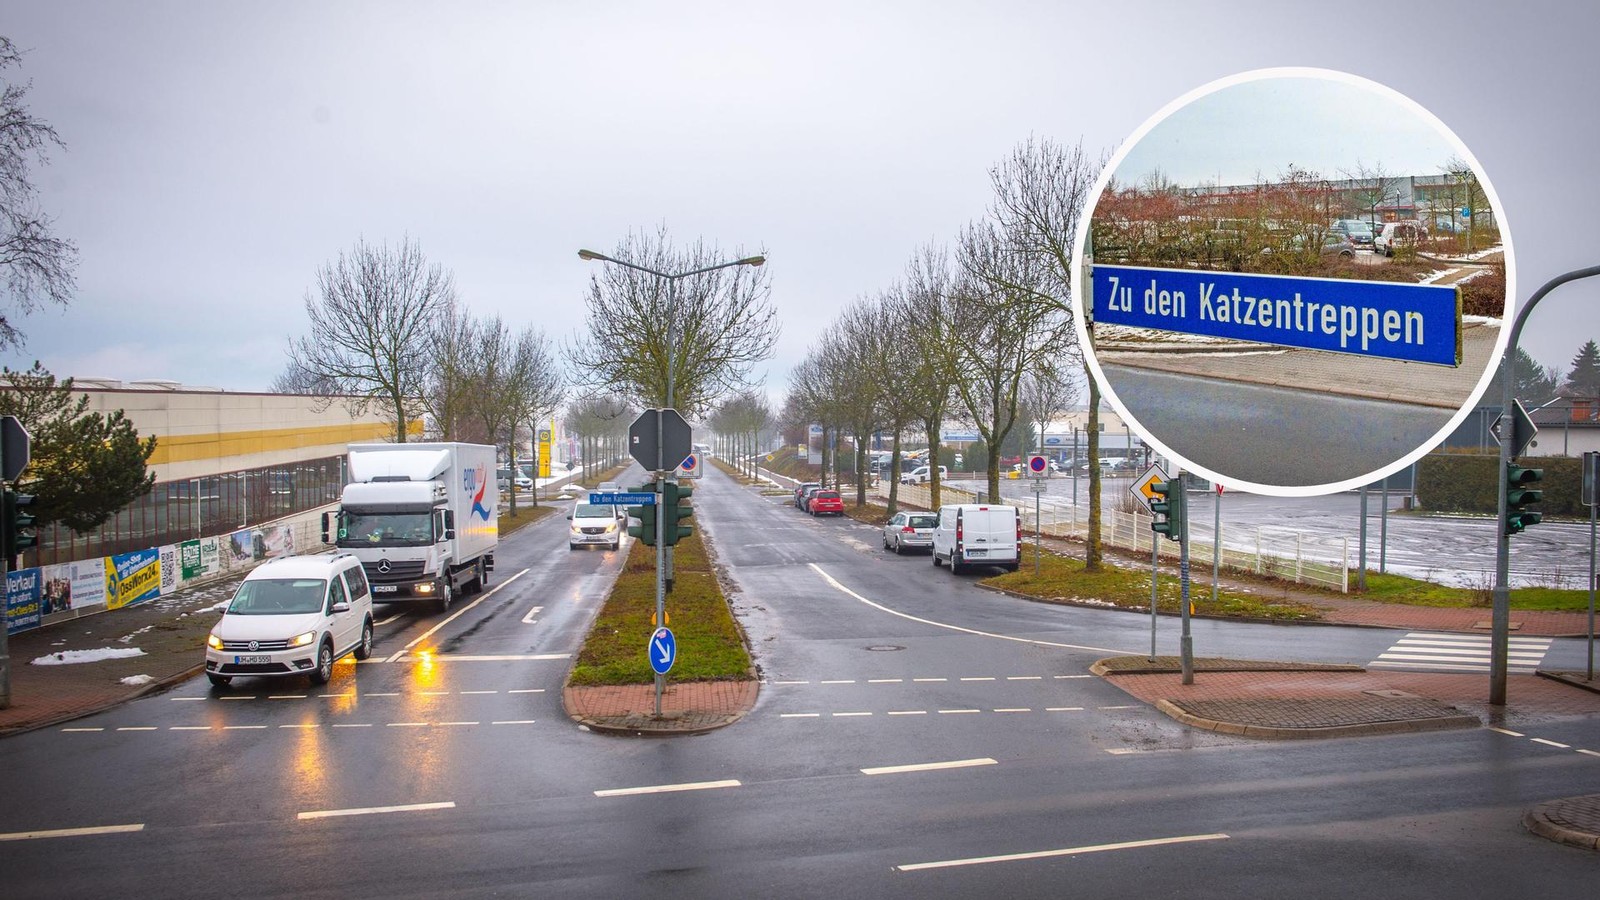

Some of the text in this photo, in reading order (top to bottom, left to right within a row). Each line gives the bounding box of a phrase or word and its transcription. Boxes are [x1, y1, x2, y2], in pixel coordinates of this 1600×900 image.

[1108, 276, 1424, 351] Zu den Katzentreppen
[593, 495, 652, 504] Zu den Katzentreppen
[6, 572, 36, 594] Verkauf
